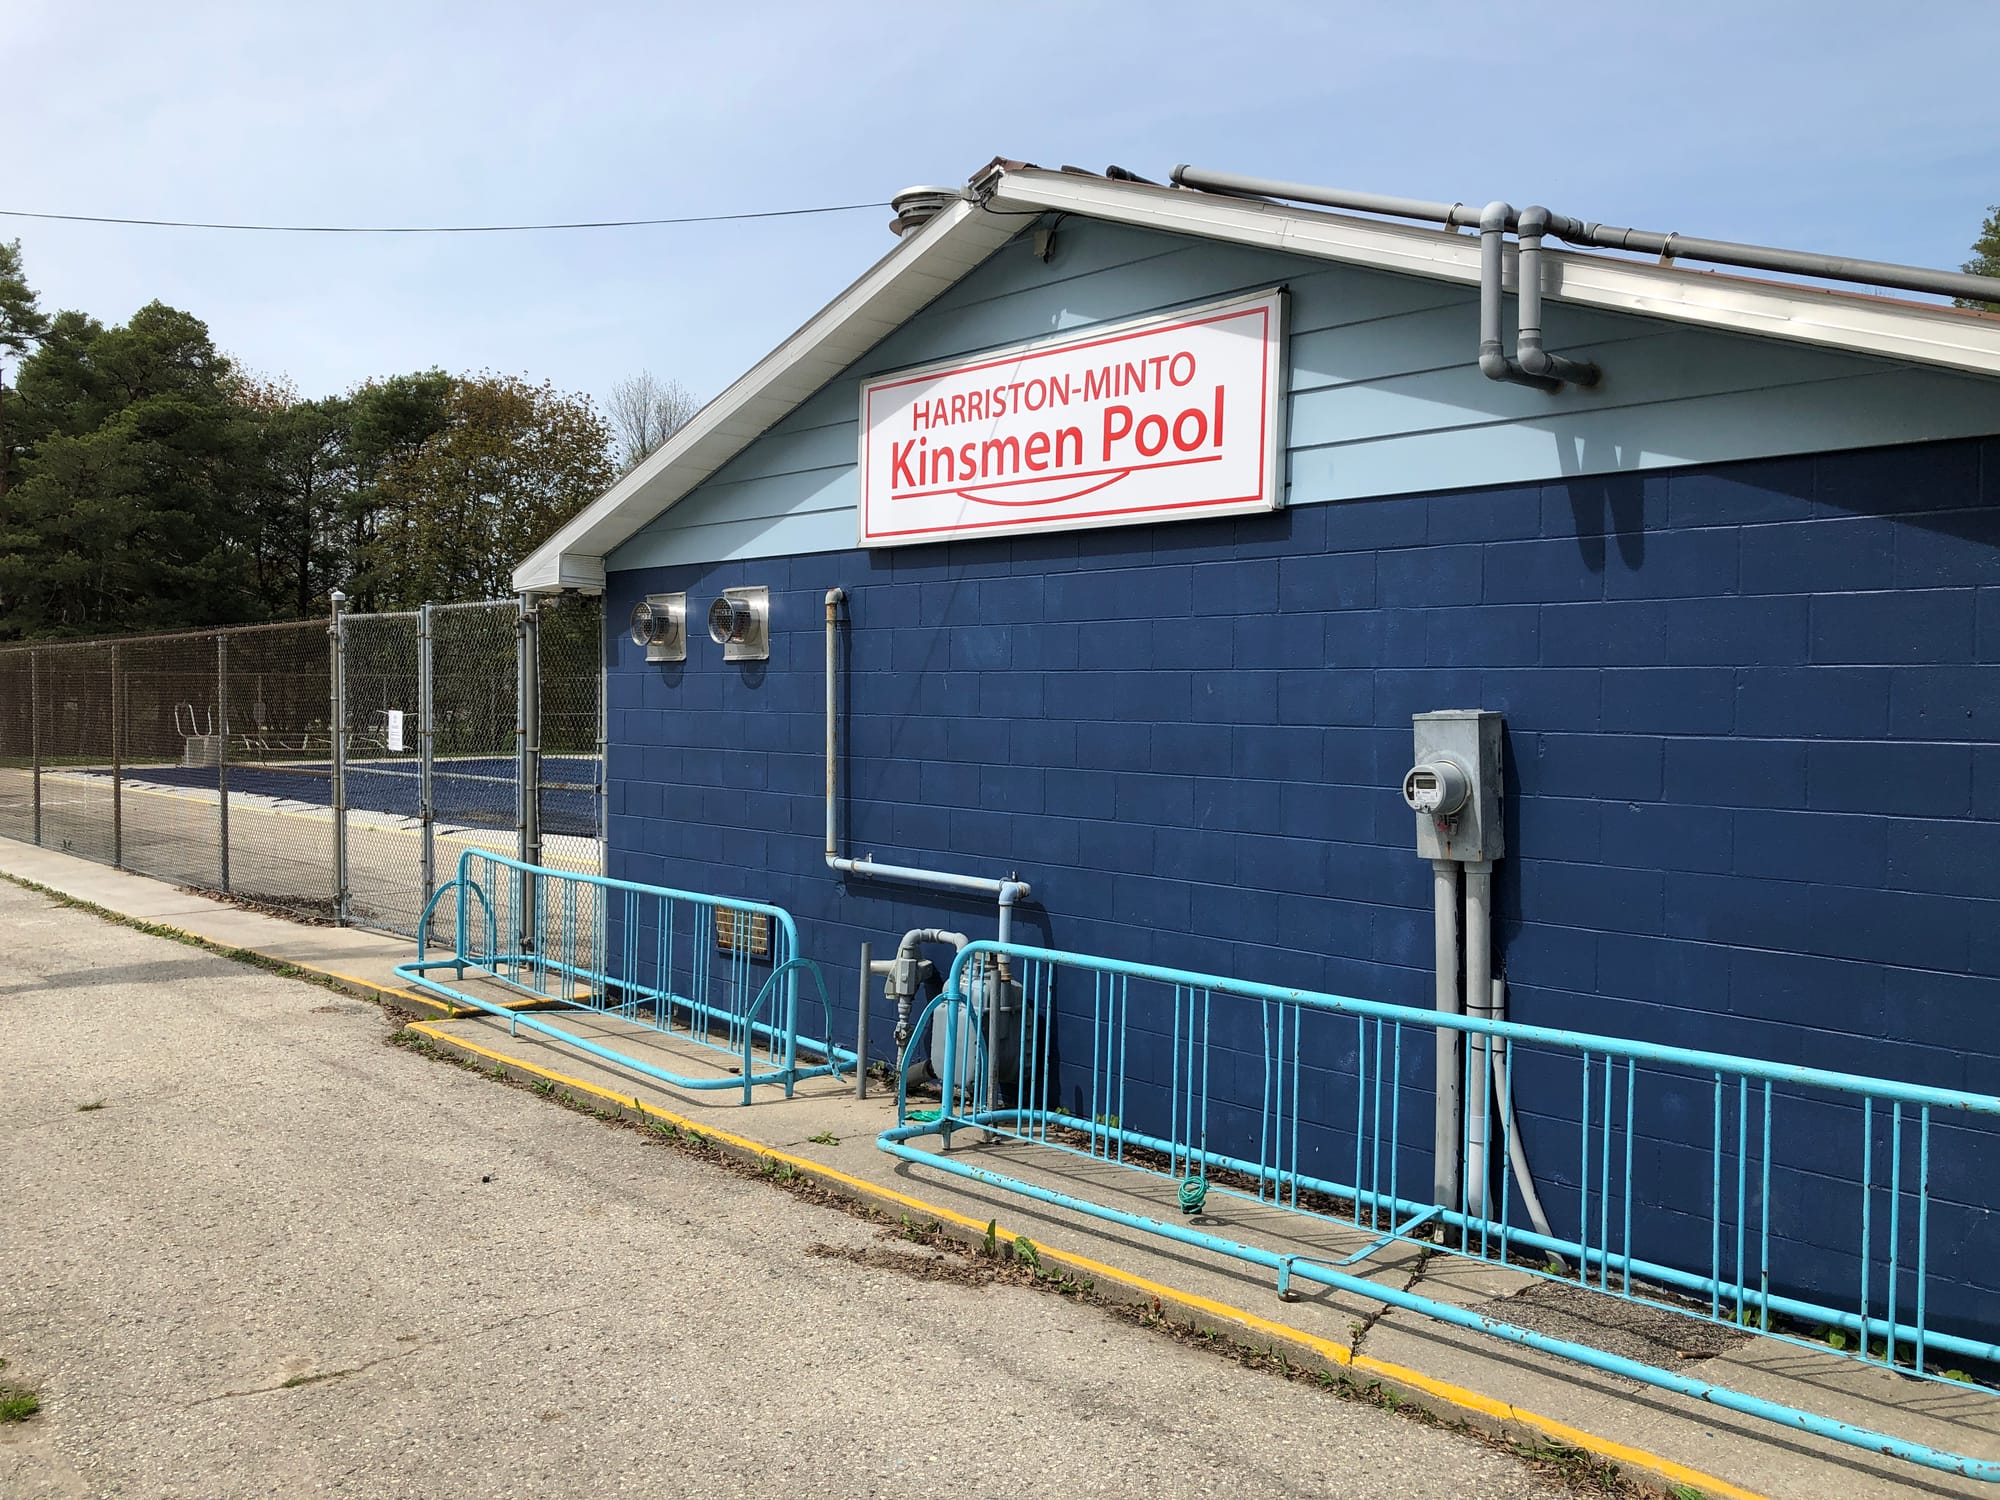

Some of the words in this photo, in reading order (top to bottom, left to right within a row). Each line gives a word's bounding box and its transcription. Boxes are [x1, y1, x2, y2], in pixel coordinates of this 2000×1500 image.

[891, 426, 1083, 489] Kinsmen
[1102, 385, 1224, 462] Pool
[912, 351, 1196, 431] HARRISTON-MINTO
